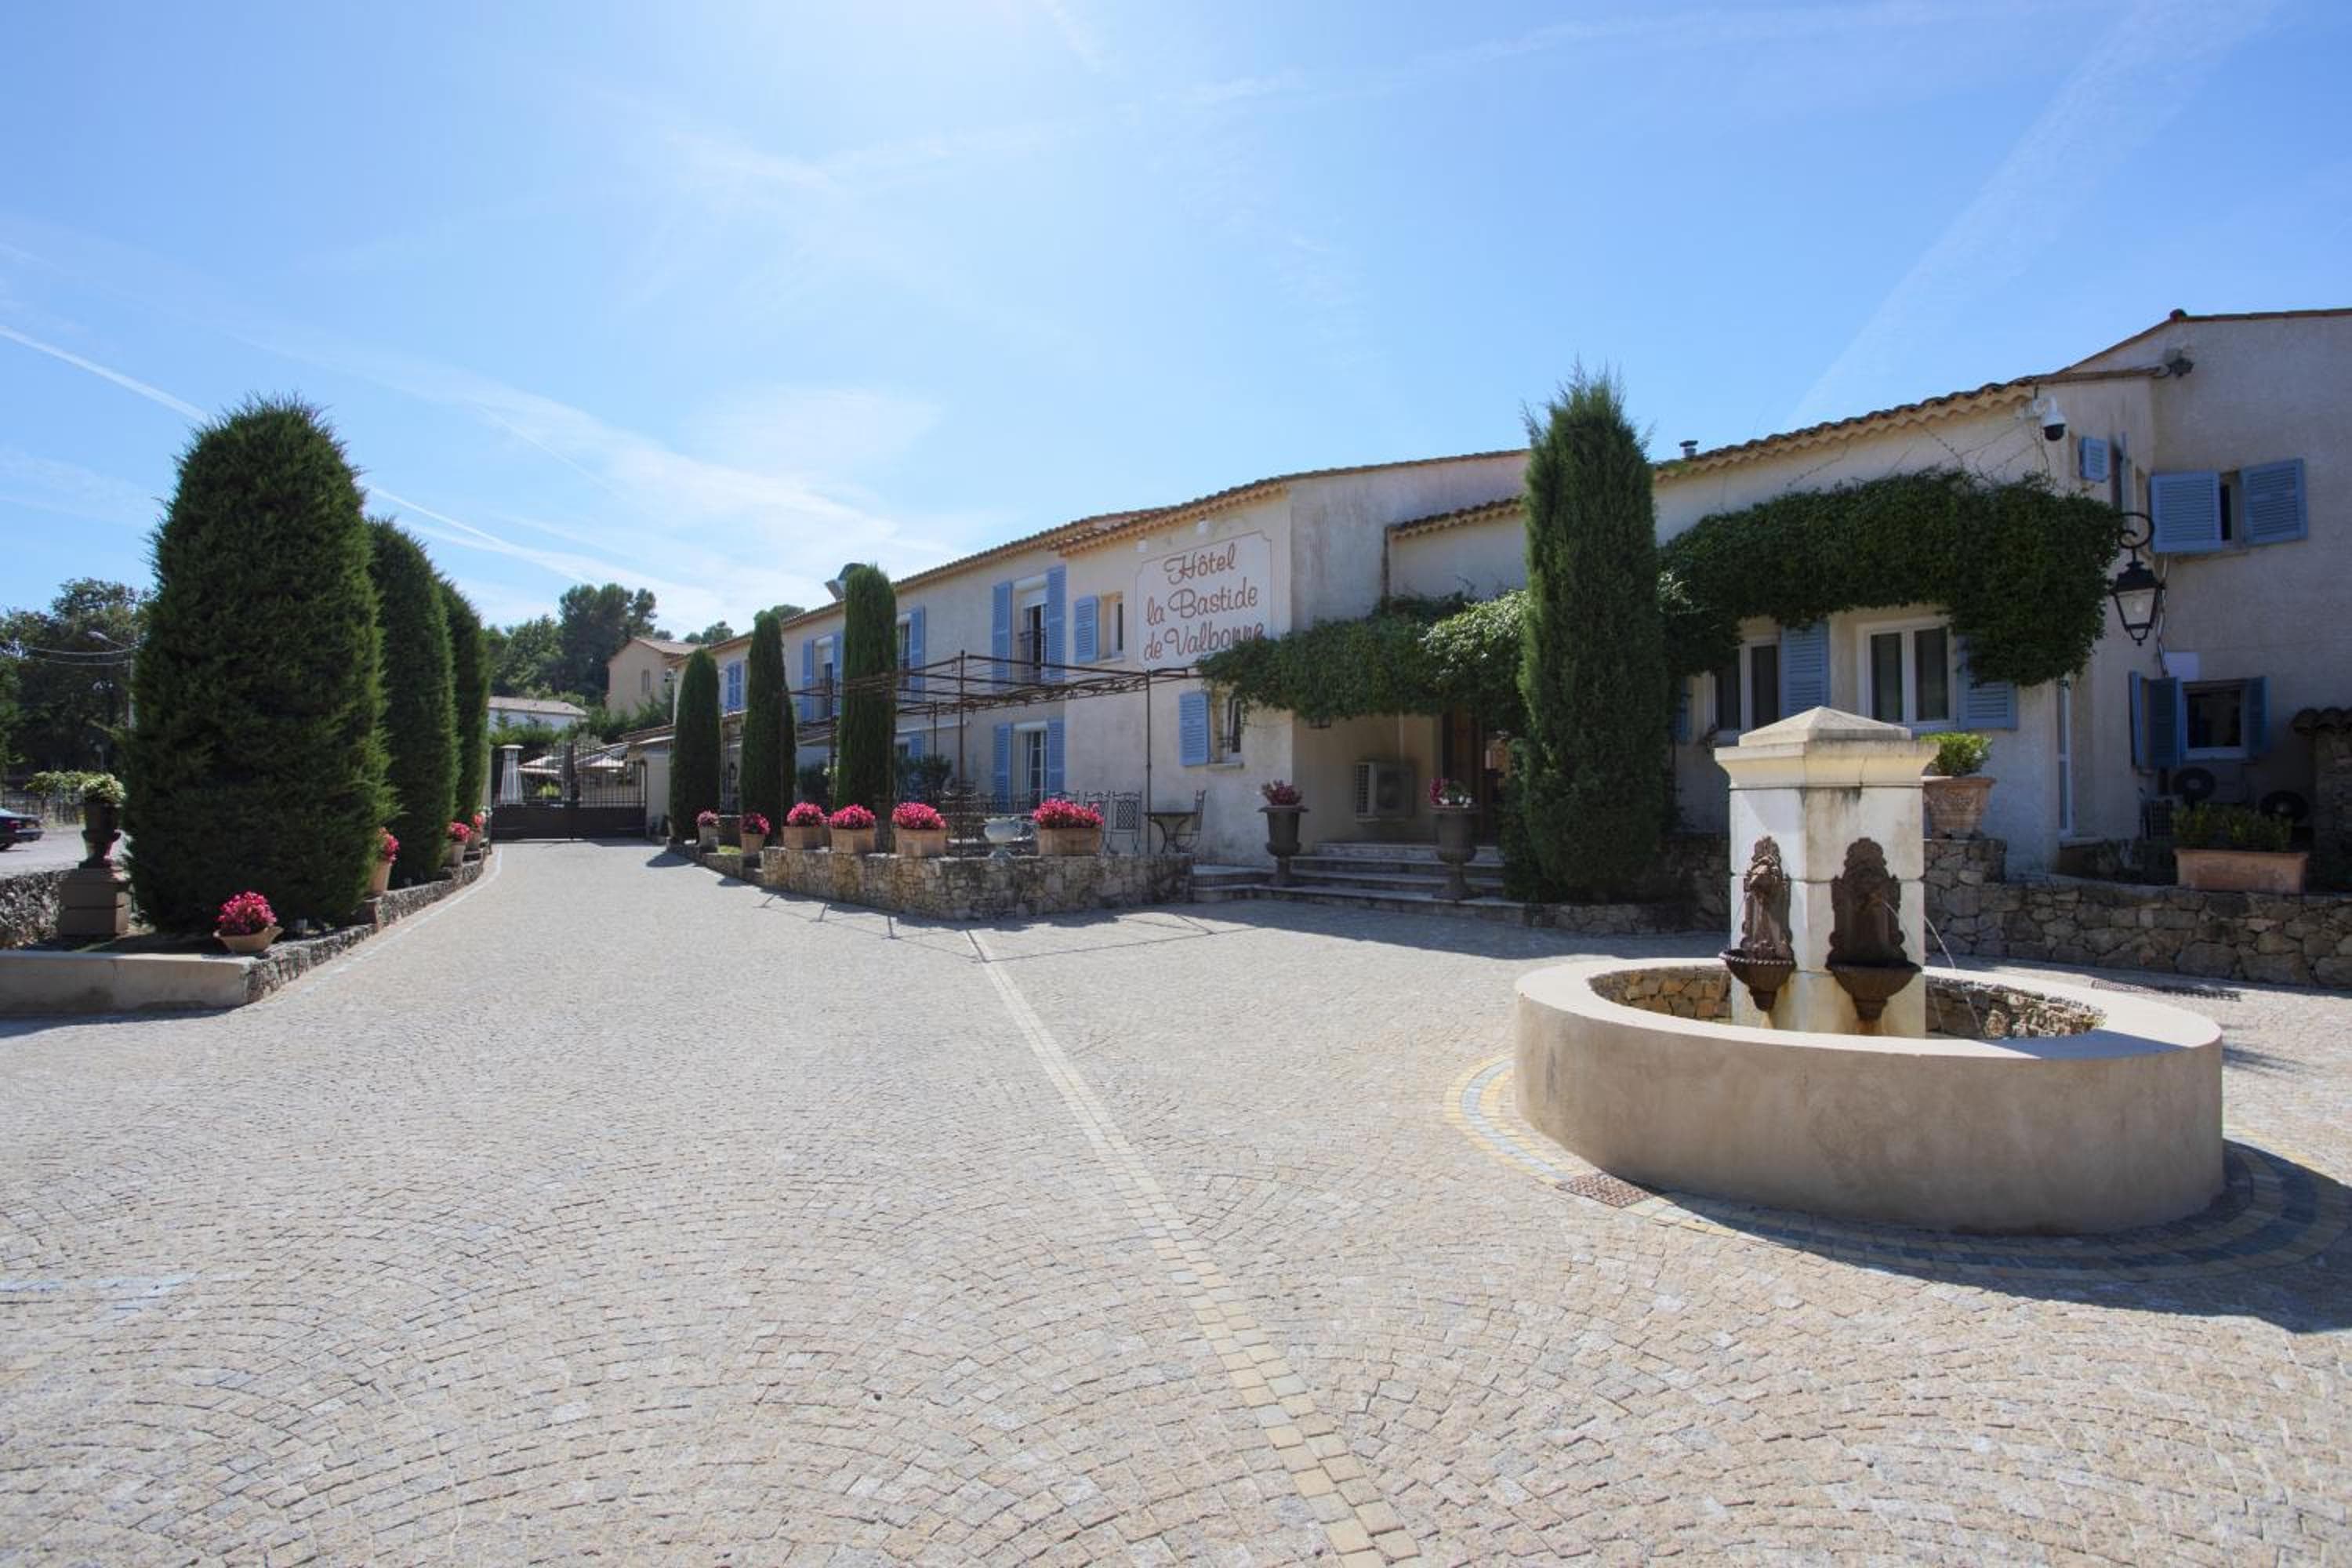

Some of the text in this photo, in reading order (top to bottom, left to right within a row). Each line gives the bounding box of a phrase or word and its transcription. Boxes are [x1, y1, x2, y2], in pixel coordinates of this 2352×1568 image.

[1163, 542, 1236, 585] Hôtel
[1147, 576, 1258, 626] la Bastide
[1144, 631, 1163, 660] de
